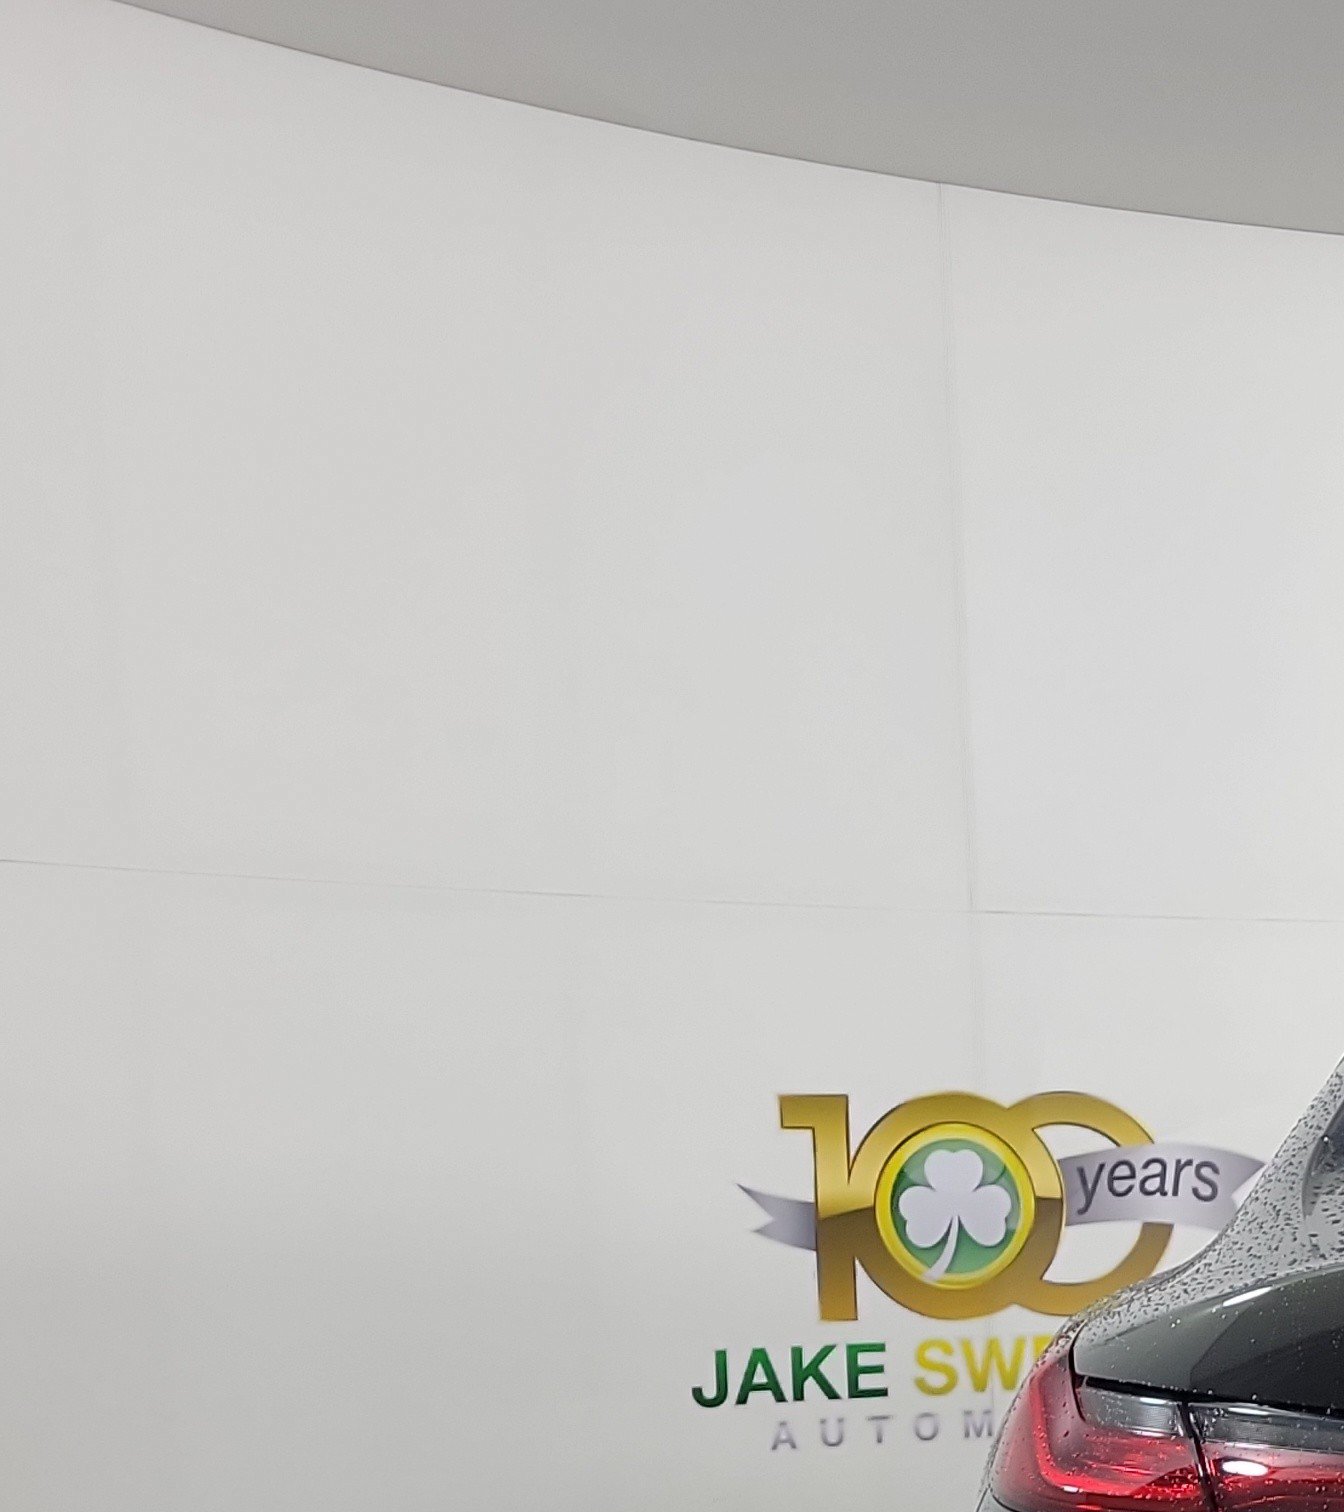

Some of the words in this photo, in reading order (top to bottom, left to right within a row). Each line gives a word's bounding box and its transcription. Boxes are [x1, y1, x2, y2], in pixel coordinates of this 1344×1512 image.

[779, 1091, 1174, 1320] 100
[1077, 1153, 1219, 1215] years
[692, 1342, 888, 1408] JAKE
[772, 1408, 994, 1450] AUTOM
